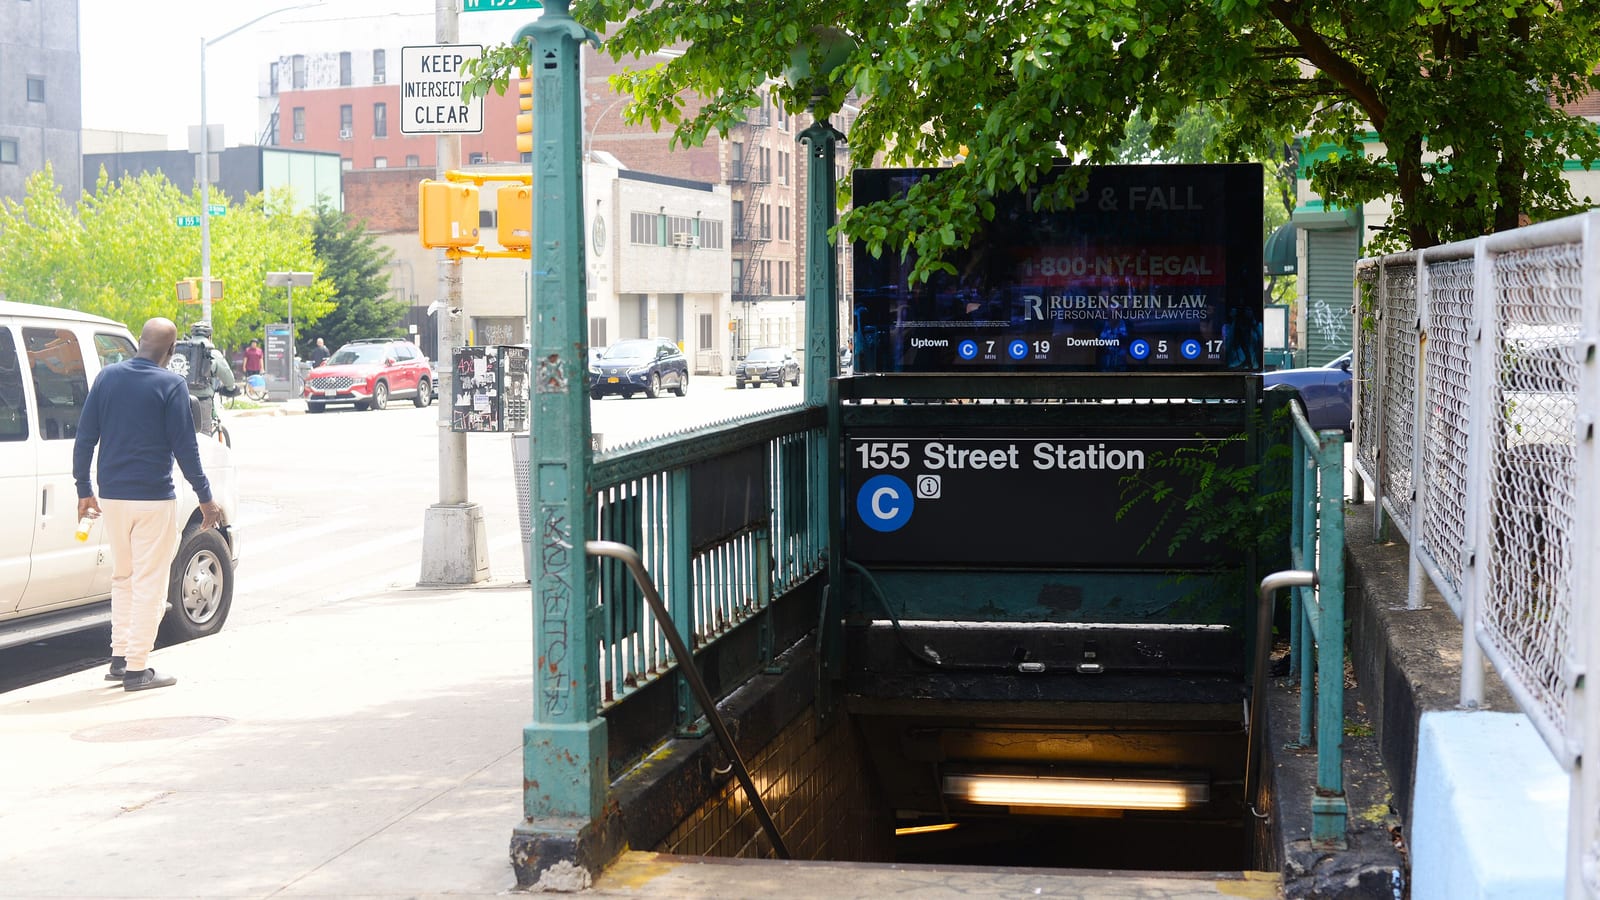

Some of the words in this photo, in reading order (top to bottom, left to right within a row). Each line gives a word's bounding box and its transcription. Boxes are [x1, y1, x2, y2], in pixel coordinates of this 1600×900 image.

[421, 54, 463, 73] KEEP
[404, 81, 477, 98] INTERSECT
[415, 105, 469, 124] CLEAR
[1098, 186, 1119, 211] &
[1129, 186, 1203, 211] FALL
[1050, 295, 1162, 309] RUBENSTEIN
[1050, 310, 1109, 320] PERSONAL
[1111, 310, 1151, 320] INJURY
[1155, 310, 1207, 320] LAWYERS
[911, 338, 949, 349] Uptown
[962, 343, 974, 356] C
[985, 341, 996, 353] 7
[1012, 343, 1024, 356] C
[1032, 340, 1051, 353] 19
[1066, 337, 1120, 347] Downtown
[1134, 343, 1146, 356] C
[1157, 340, 1168, 353] 5
[1185, 343, 1197, 355] C
[1205, 340, 1223, 353] 17
[855, 442, 911, 470] 155
[922, 442, 1020, 470] Street
[1032, 442, 1145, 470] Station
[871, 486, 900, 520] C
